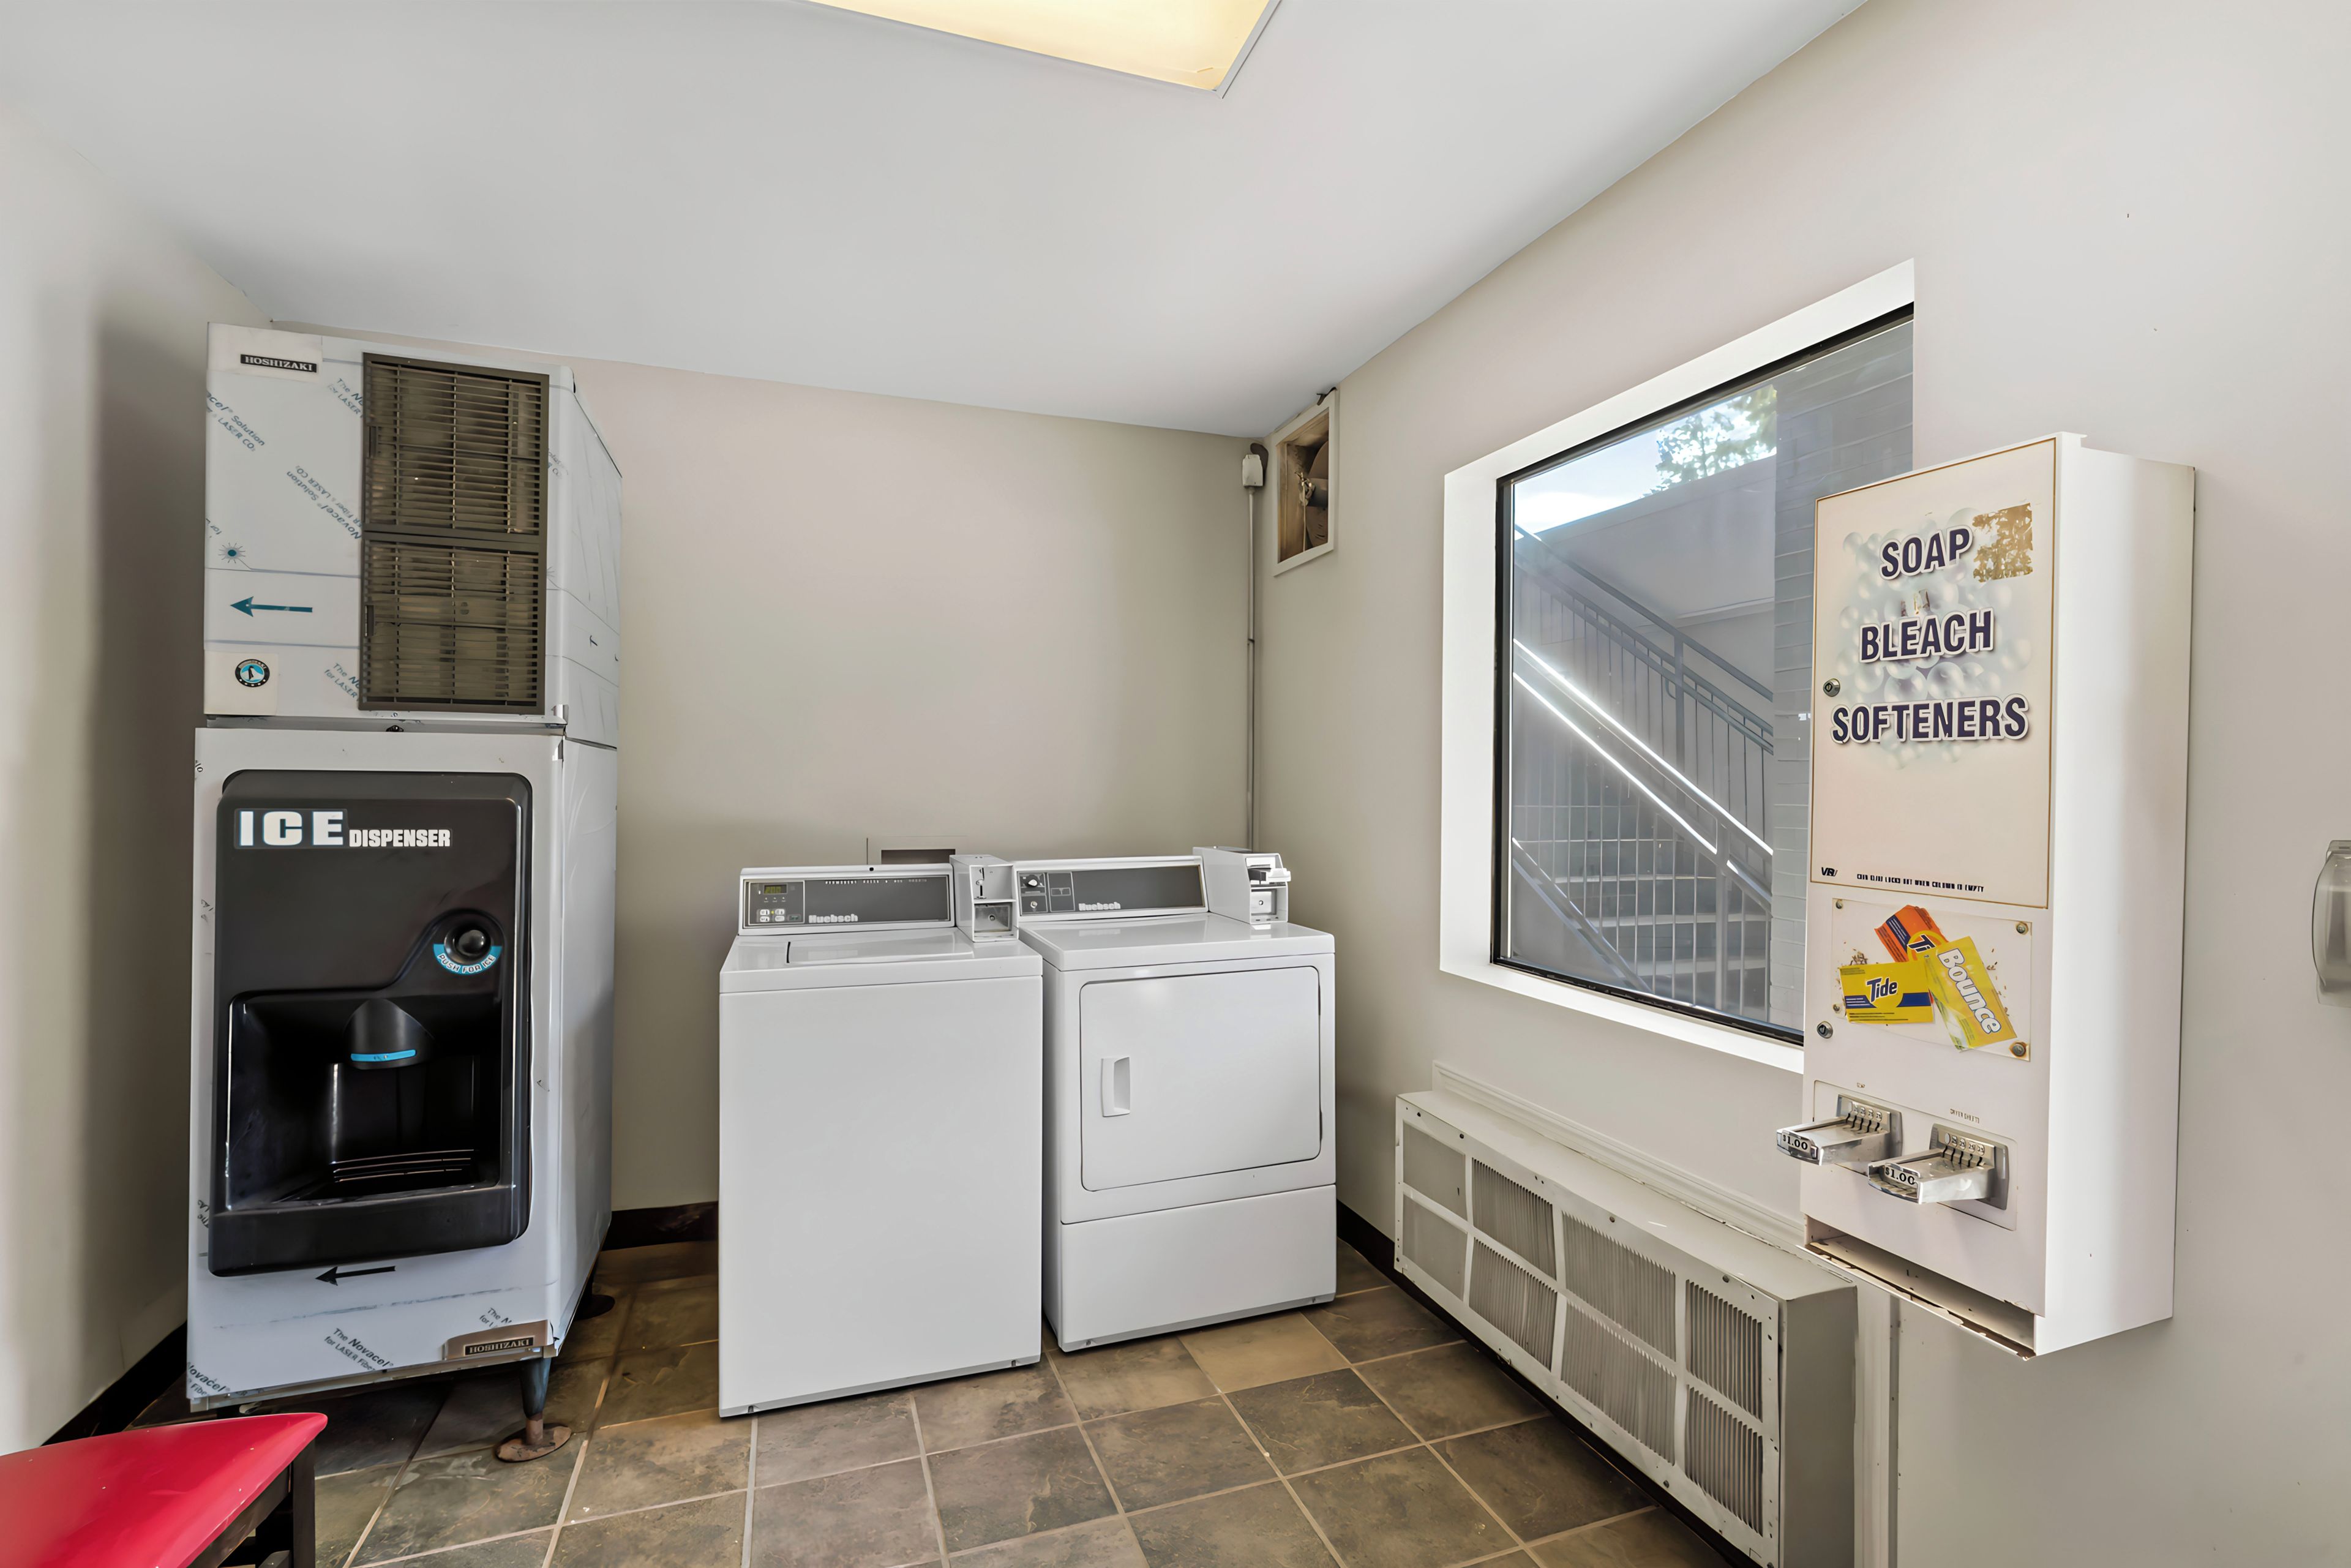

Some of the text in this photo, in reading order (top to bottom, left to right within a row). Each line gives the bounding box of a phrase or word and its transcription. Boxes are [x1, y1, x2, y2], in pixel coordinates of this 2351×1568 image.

[244, 356, 313, 371] HOSHIZAKI
[337, 394, 361, 415] LASER
[231, 415, 265, 446] Solution
[287, 471, 319, 501] Solution
[308, 478, 331, 499] LASER
[1880, 527, 1973, 579] SOAP
[1860, 609, 1993, 662] BLEACH
[334, 678, 358, 698] LASER
[1831, 695, 2028, 744] SOFTENERS
[238, 810, 451, 847] ICE DISPENSER
[809, 913, 858, 923] Huebsch
[1907, 934, 1936, 953] Ti
[438, 953, 497, 973] PUSH FOR ICE
[1866, 977, 1897, 1002] Tide
[1937, 947, 2001, 1035] Bounce
[1782, 1134, 1808, 1150] $1.00
[1885, 1168, 1916, 1185] $1.00
[487, 1308, 501, 1320] The
[324, 1335, 337, 1346] for
[332, 1327, 348, 1341] The
[469, 1338, 530, 1354] HOSHIZAKI
